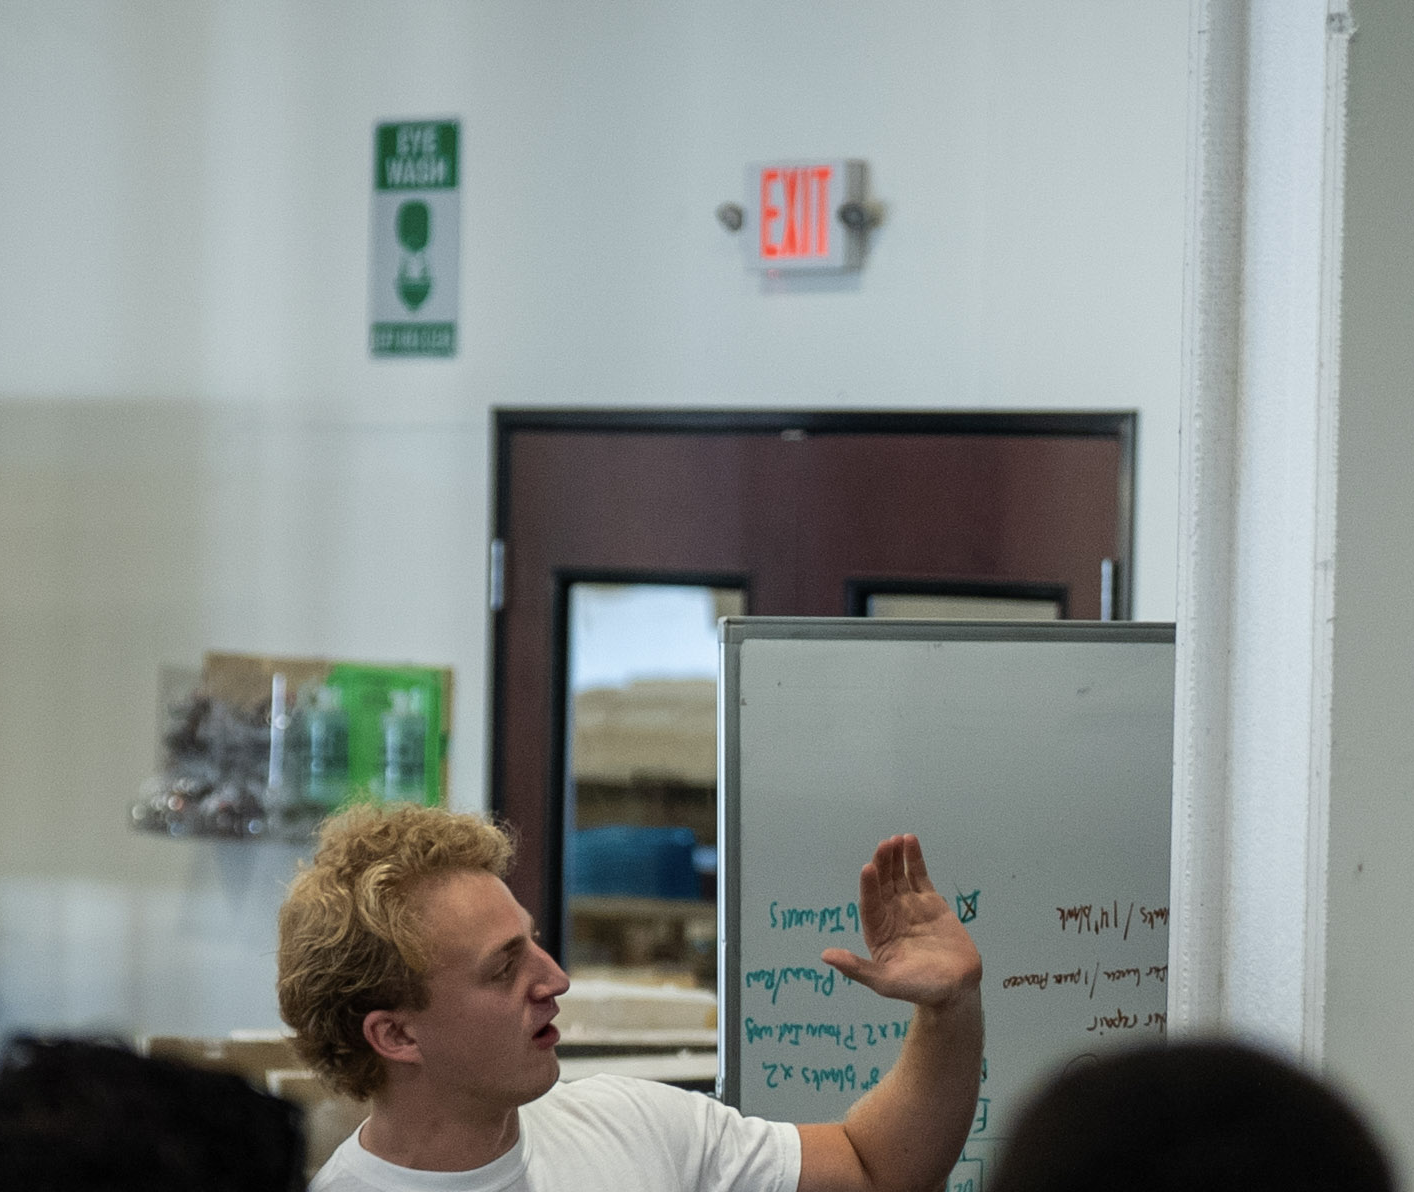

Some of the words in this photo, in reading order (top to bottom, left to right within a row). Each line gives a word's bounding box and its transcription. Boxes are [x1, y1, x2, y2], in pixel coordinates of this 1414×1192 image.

[396, 125, 437, 155] EYE
[385, 155, 445, 185] WASH
[760, 165, 833, 259] EXIT
[1086, 1009, 1137, 1035] repair
[801, 1064, 856, 1092] blanks
